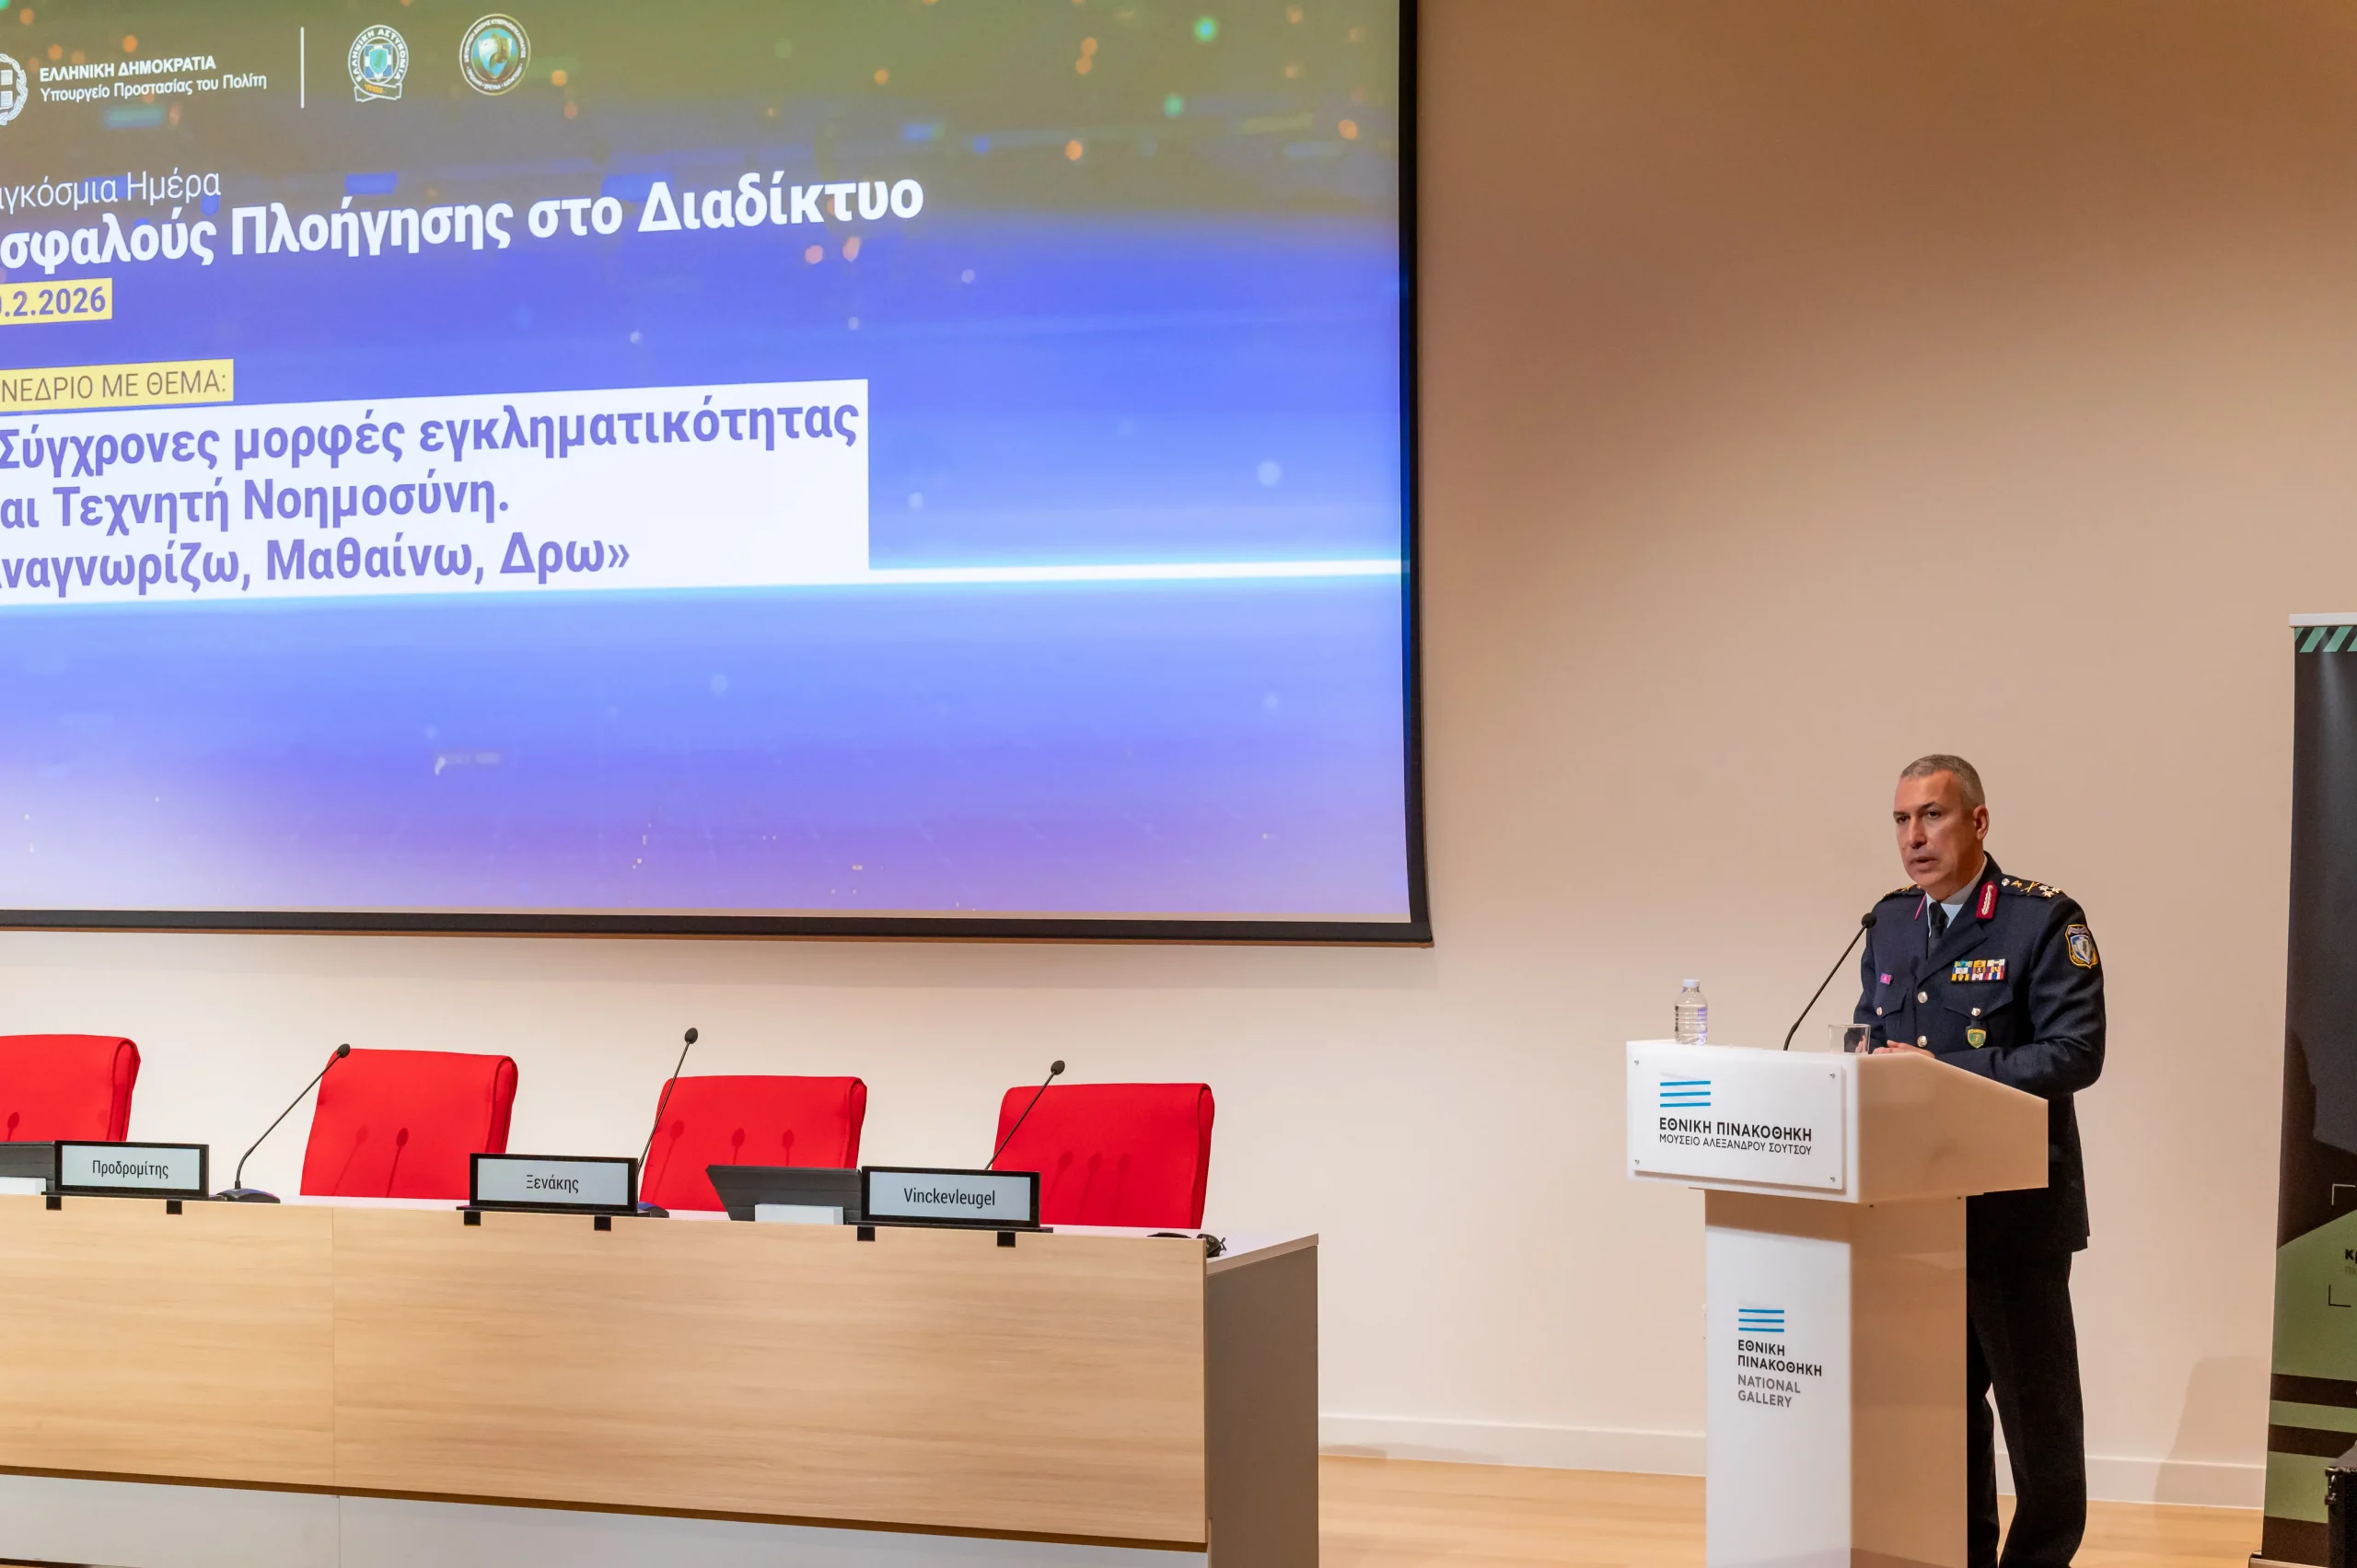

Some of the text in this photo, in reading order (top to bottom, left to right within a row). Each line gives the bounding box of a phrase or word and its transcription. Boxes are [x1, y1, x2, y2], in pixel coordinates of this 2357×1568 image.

[40, 55, 216, 83] ΕΛΛΗΝΙΚΗ ΔΗΜΟΚΡΑΤΙΑ
[41, 73, 267, 102] Υπουργείο Προστασίας του Πολίτη
[127, 168, 221, 205] Ημέρα
[0, 170, 923, 274] σφαλούς Πλοήγησης στο Διαδίκτυο
[0, 286, 106, 317] .2.2026
[2, 369, 226, 402] ΝΕΔΡΙΟ ΜΕ ΘΕΜΑ:
[0, 396, 859, 478] Σύγχρονες μορφές εγκληματικότητας
[1, 469, 508, 536] αι Τεχνητή Νοημοσύνη.
[0, 532, 630, 598] ναγνωρίζω, Μαθαίνω, Δρω»
[1659, 1118, 1812, 1142] ΕΘΝΙΚΗ ΠΙΝΑΚΟΘΗΚΗ
[1659, 1133, 1812, 1156] ΜΟΥΣΕΙΟ ΑΛΕΞΑΝΔΡΟΥ ΣΟΥΤΣΟΥ
[92, 1160, 168, 1179] Προδρομίτης
[527, 1174, 579, 1193] Ξενάκης
[904, 1188, 995, 1209] Vinckevleugel
[1738, 1340, 1785, 1356] ΕΘΝΙΚΗ
[1738, 1354, 1822, 1376] ΠΙΝΑΚΟΘΗΚΗ
[1738, 1374, 1800, 1393] NATIONAL
[1738, 1389, 1792, 1408] GALLERY
